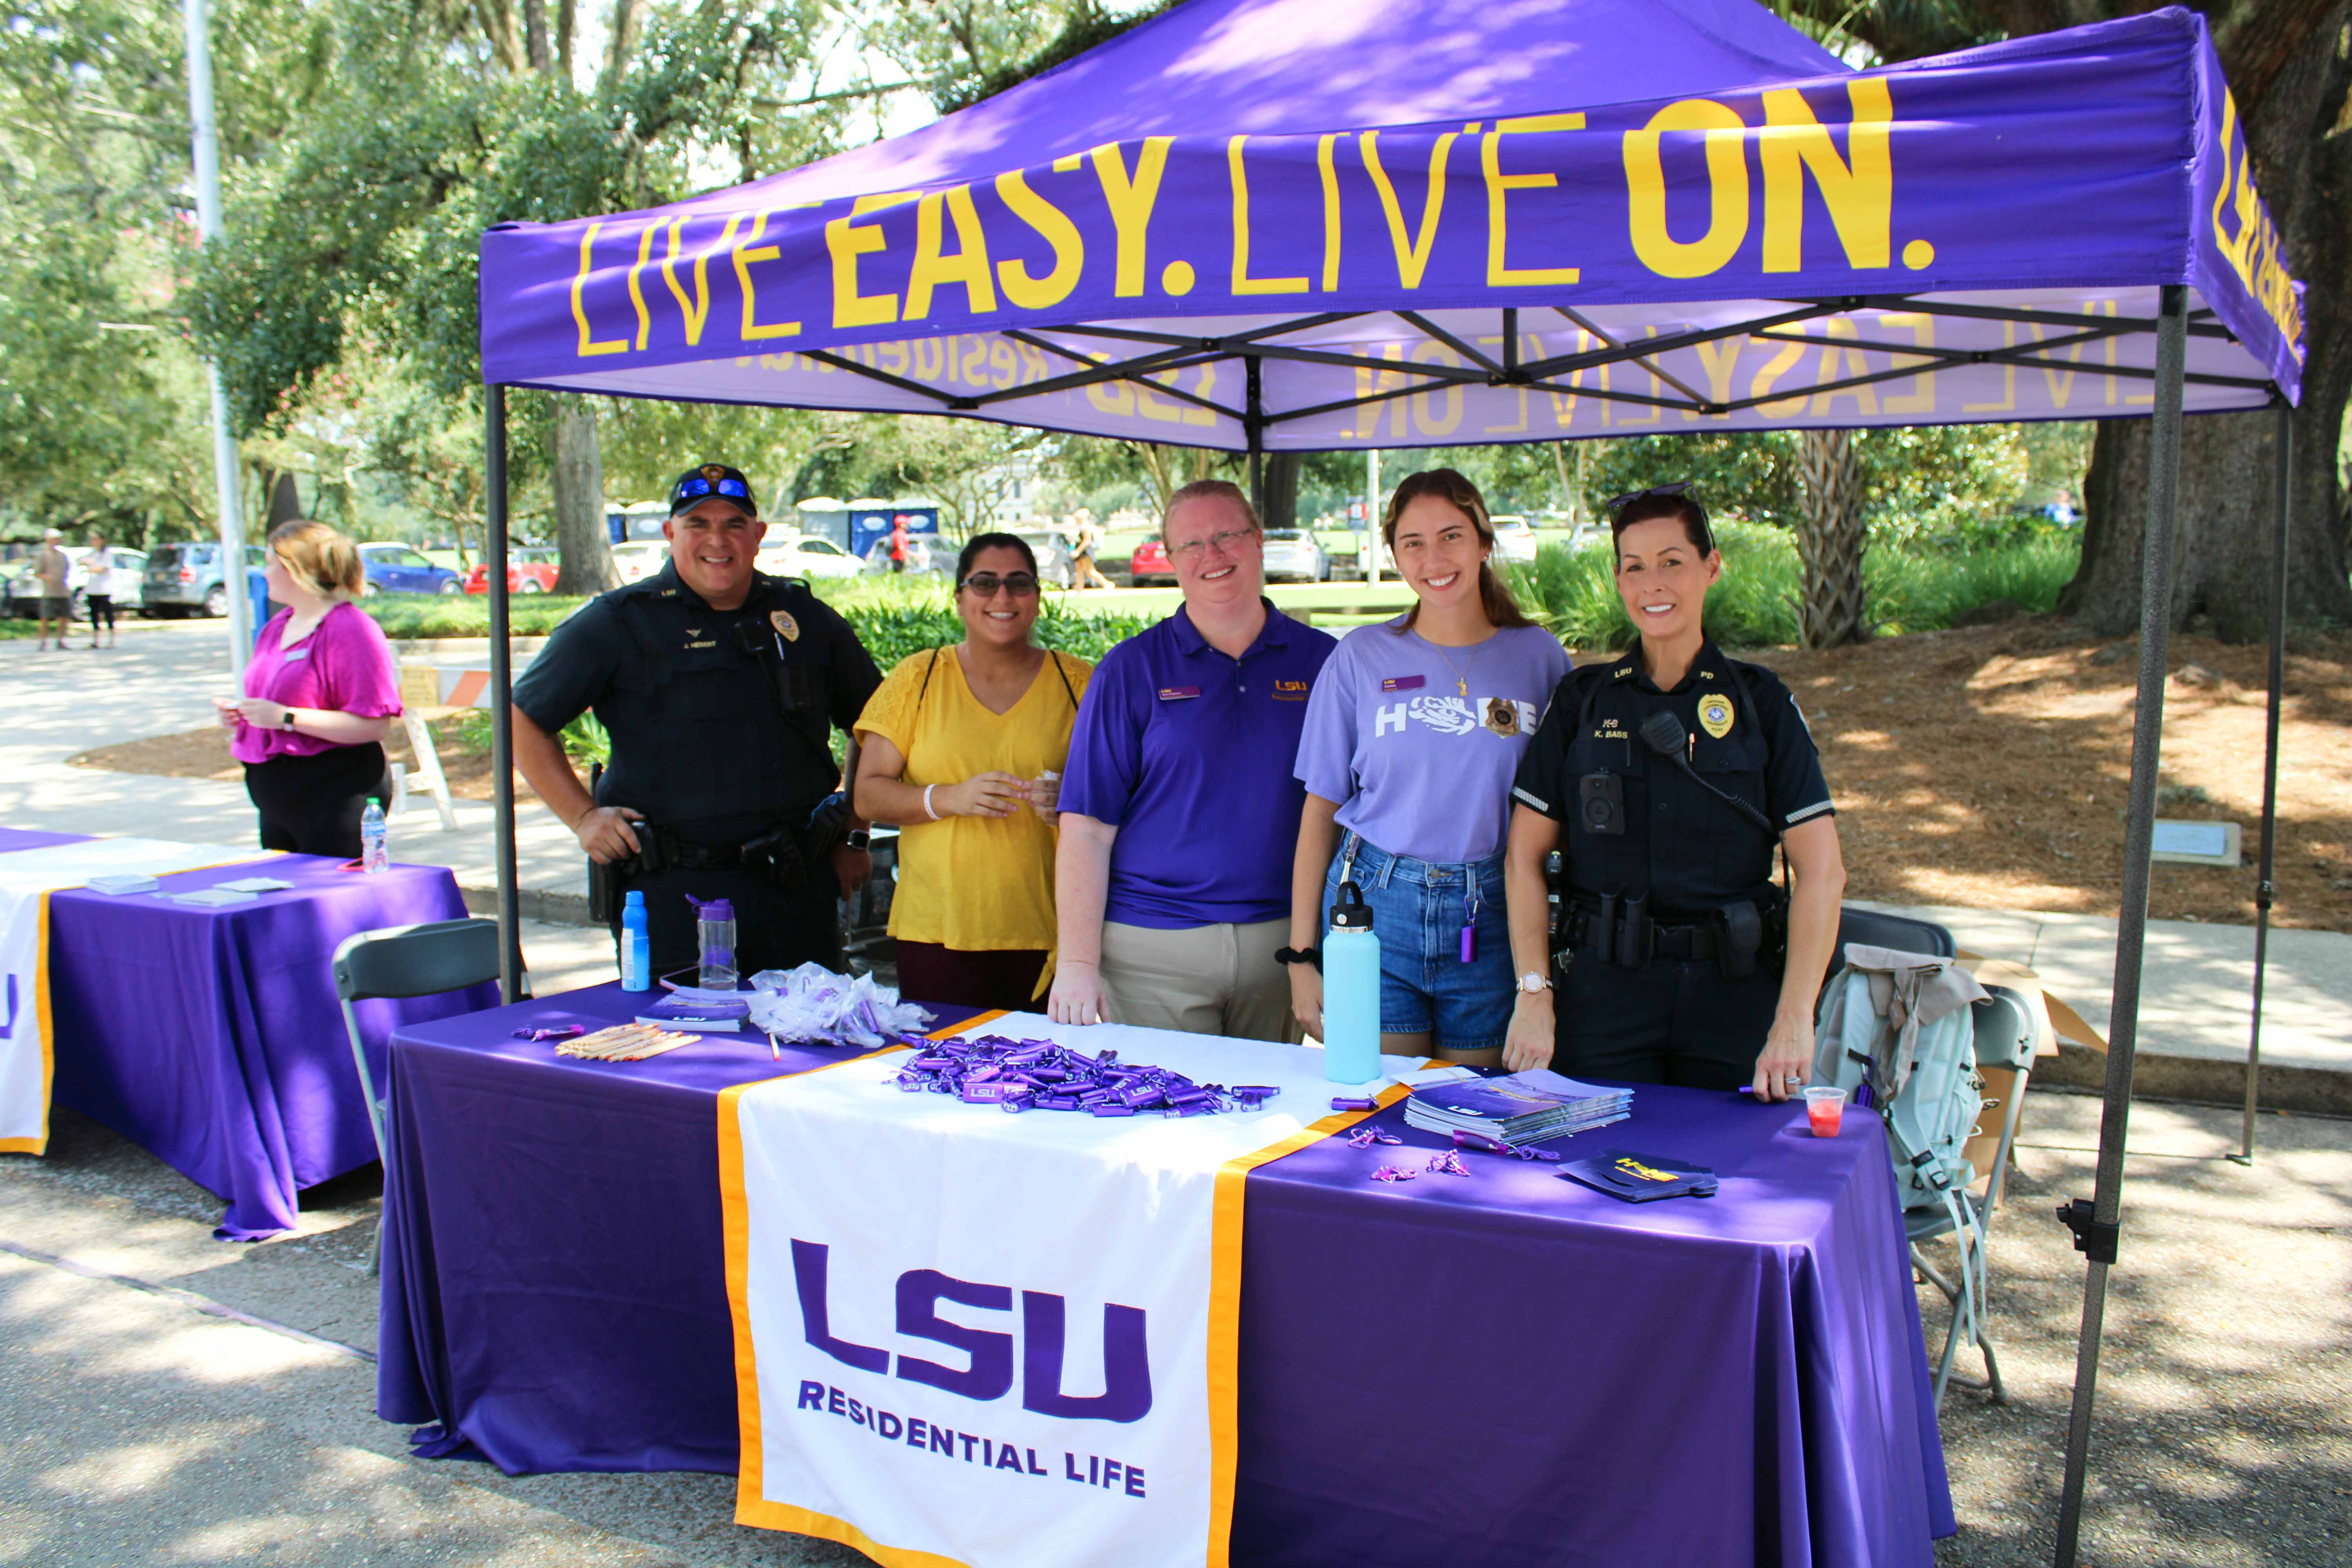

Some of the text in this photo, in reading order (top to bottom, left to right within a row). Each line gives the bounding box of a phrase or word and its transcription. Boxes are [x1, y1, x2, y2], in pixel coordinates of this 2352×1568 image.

[571, 76, 1935, 357] LIVE EASY. LIVE ON.
[1614, 667, 1632, 678] LSU
[1700, 671, 1714, 679] PD
[1275, 679, 1308, 691] LSU
[1605, 730, 1628, 739] BASS
[969, 1064, 992, 1078] LSU
[971, 1088, 996, 1098] LSU
[1130, 1084, 1153, 1097] LSU
[790, 1238, 1152, 1424] LSU
[797, 1380, 1146, 1499] RESIDENTIAL LIFE
